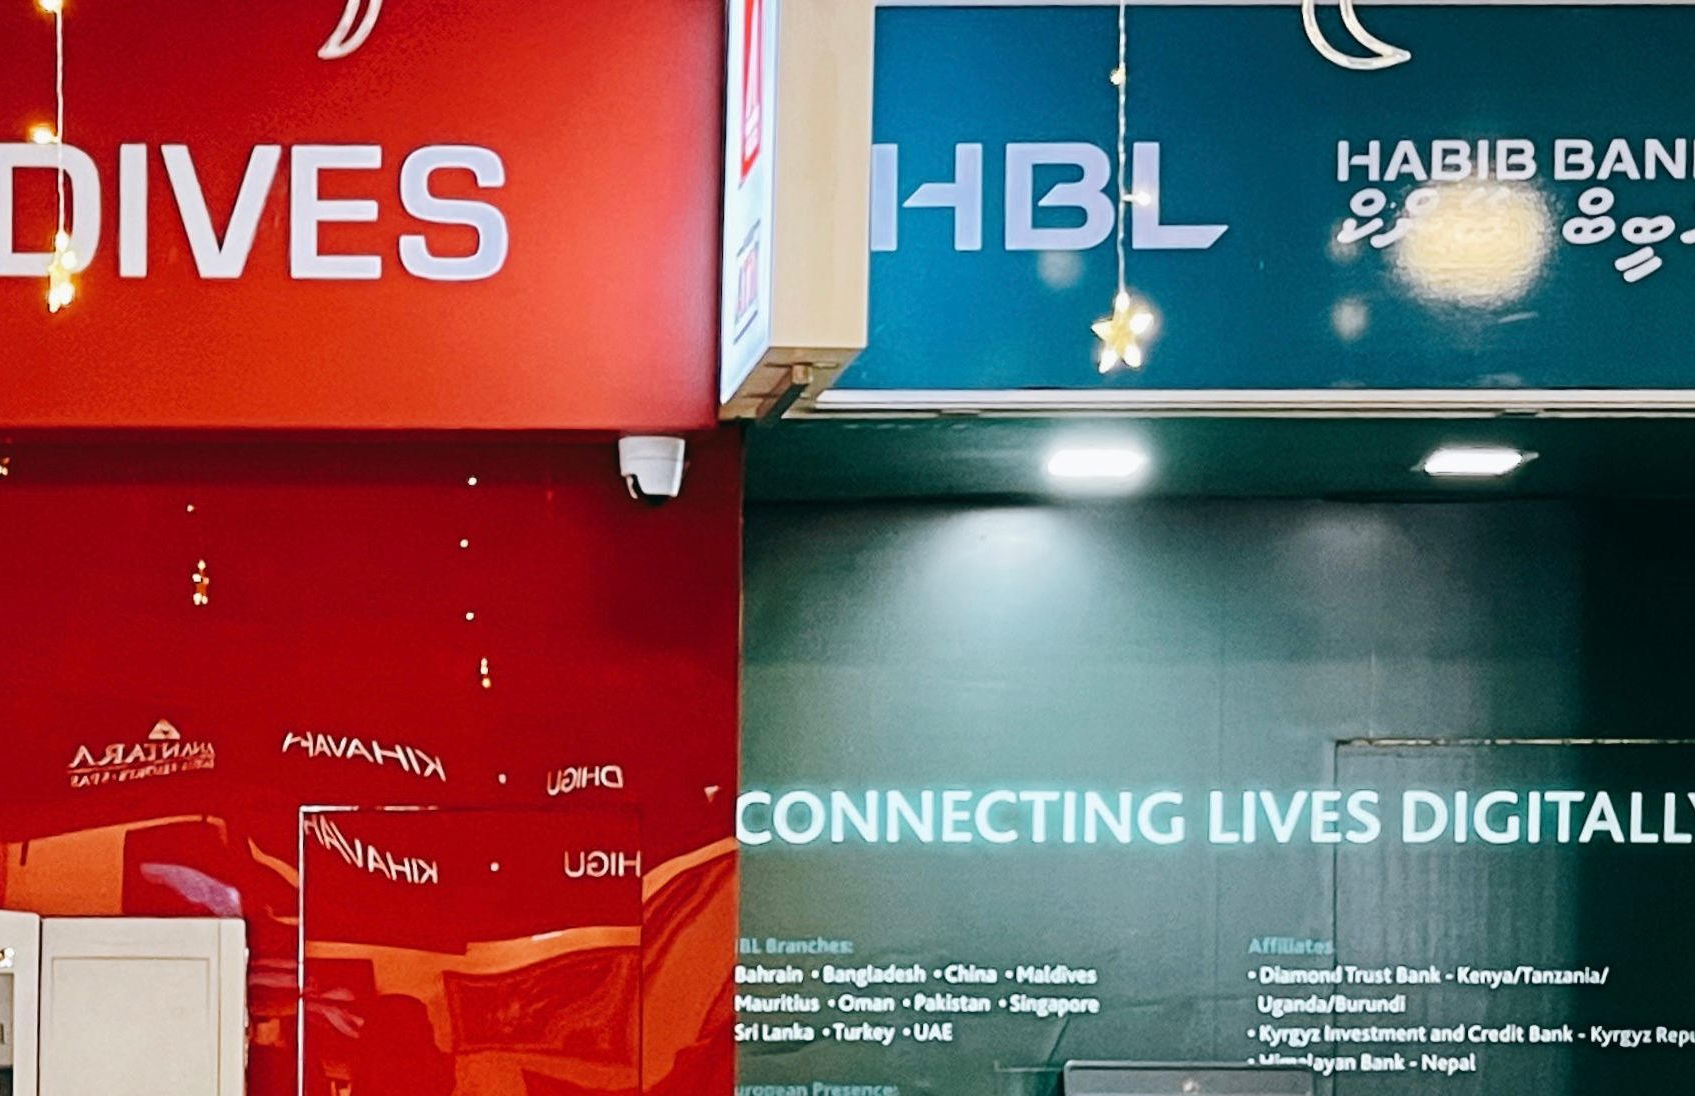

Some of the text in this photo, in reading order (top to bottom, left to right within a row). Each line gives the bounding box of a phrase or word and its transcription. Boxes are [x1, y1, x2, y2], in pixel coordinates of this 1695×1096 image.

[1337, 139, 1695, 181] HABIB BAN
[871, 142, 1229, 250] HBL
[736, 790, 1695, 845] CONNECTING LIVES DIGITALL
[735, 937, 854, 955] BL Branches:
[734, 964, 1097, 988] Bahrain Bangladesh China Maldives
[1259, 965, 1343, 984] Diamond
[1344, 965, 1392, 984] Trust
[1396, 965, 1441, 984] Bank
[1457, 966, 1609, 989] Kenya/Tanzania/
[734, 993, 1100, 1018] Mauritius Oman Pakistan Singapore
[1257, 994, 1406, 1018] Uganda/Burundi
[734, 1023, 953, 1046] Sri Lanka Turkey UAE
[1259, 1024, 1321, 1047] Kyrgyz
[1324, 1024, 1427, 1043] Investment
[1430, 1024, 1465, 1043] and
[1467, 1025, 1525, 1043] Credit
[1529, 1025, 1573, 1043] Bank
[1590, 1026, 1652, 1048] Kyrgyz
[1360, 1053, 1405, 1071] Bank
[1421, 1053, 1476, 1076] Nepal
